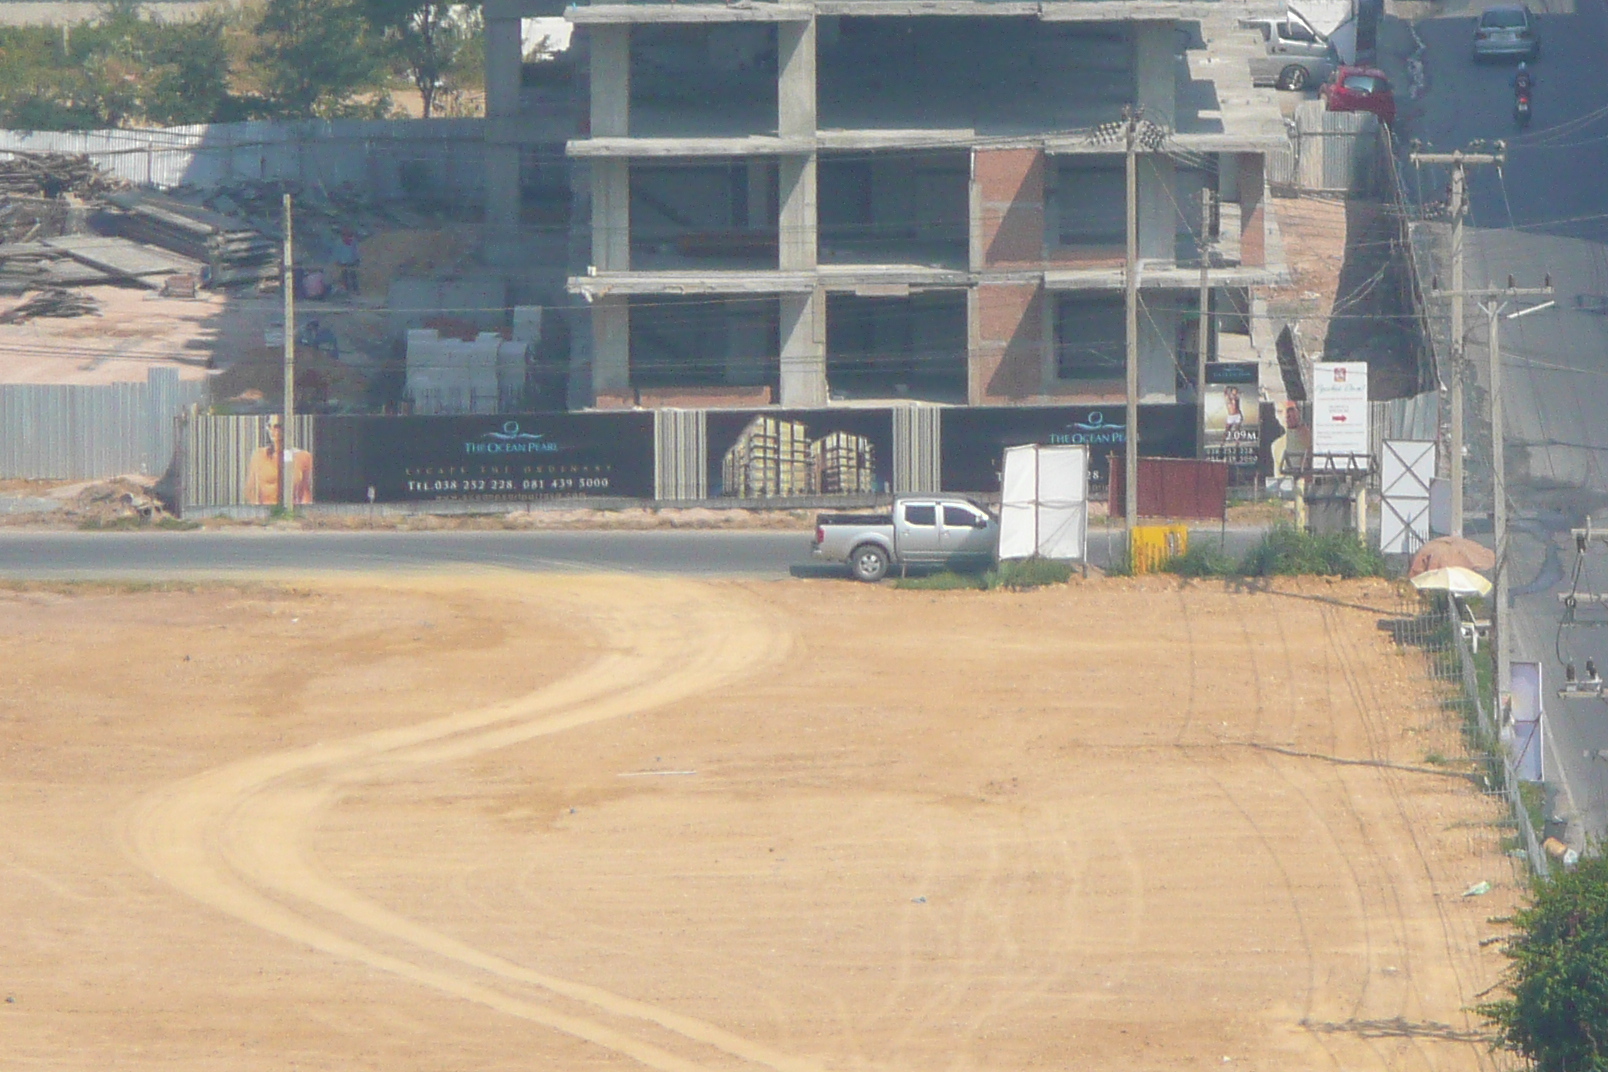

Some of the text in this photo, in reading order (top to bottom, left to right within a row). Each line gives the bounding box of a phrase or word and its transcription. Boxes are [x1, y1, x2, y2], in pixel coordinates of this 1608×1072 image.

[1050, 433, 1070, 444] THE
[1071, 432, 1110, 443] OCEAN
[486, 442, 527, 453] OCEAN
[527, 441, 558, 453] PEARL
[462, 480, 486, 490] 252
[522, 479, 544, 489] 081
[551, 479, 573, 489] 439
[578, 478, 609, 488] 5000
